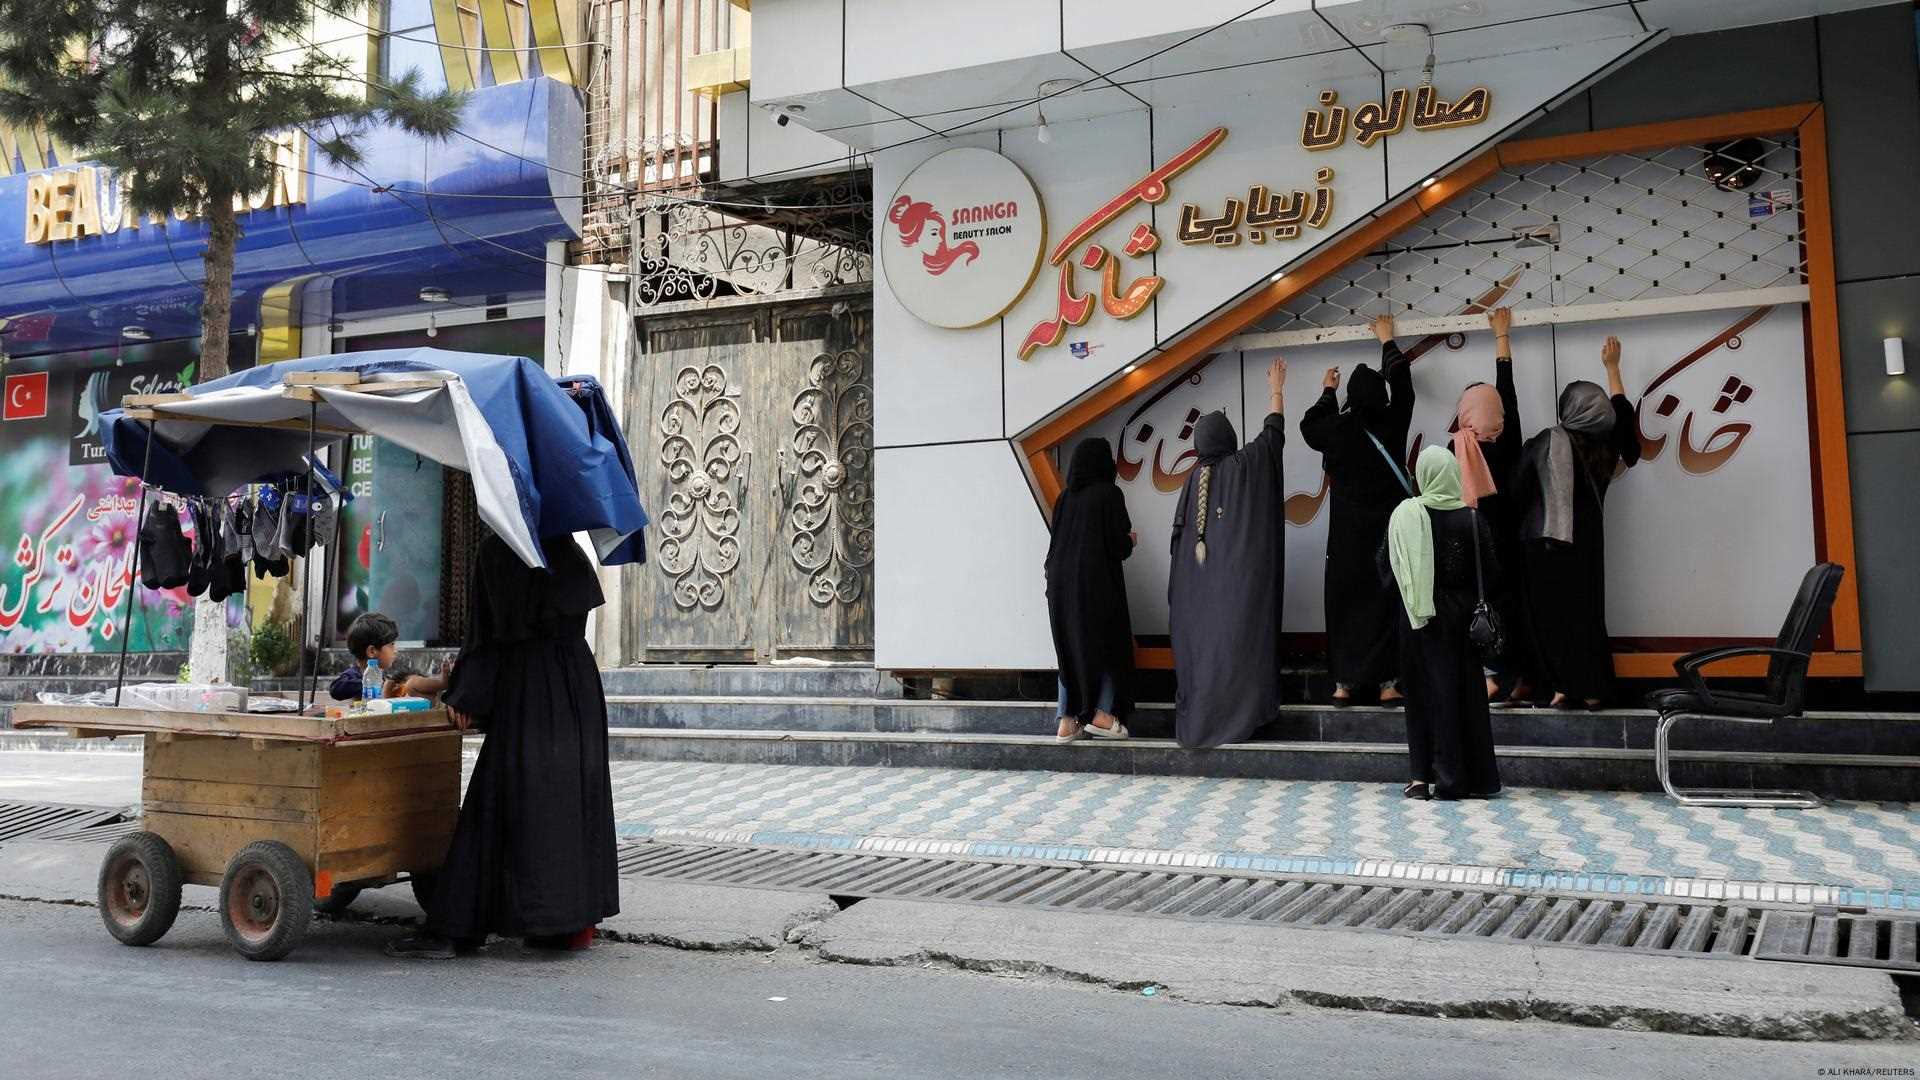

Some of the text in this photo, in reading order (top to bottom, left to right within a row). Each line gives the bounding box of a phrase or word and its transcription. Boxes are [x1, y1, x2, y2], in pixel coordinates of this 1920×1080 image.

[1302, 86, 1492, 151] صالون
[25, 164, 167, 244] BEAU
[951, 201, 1018, 226] SAANGA
[953, 225, 1012, 241] BEAUTY SALON
[81, 443, 107, 458] Tur
